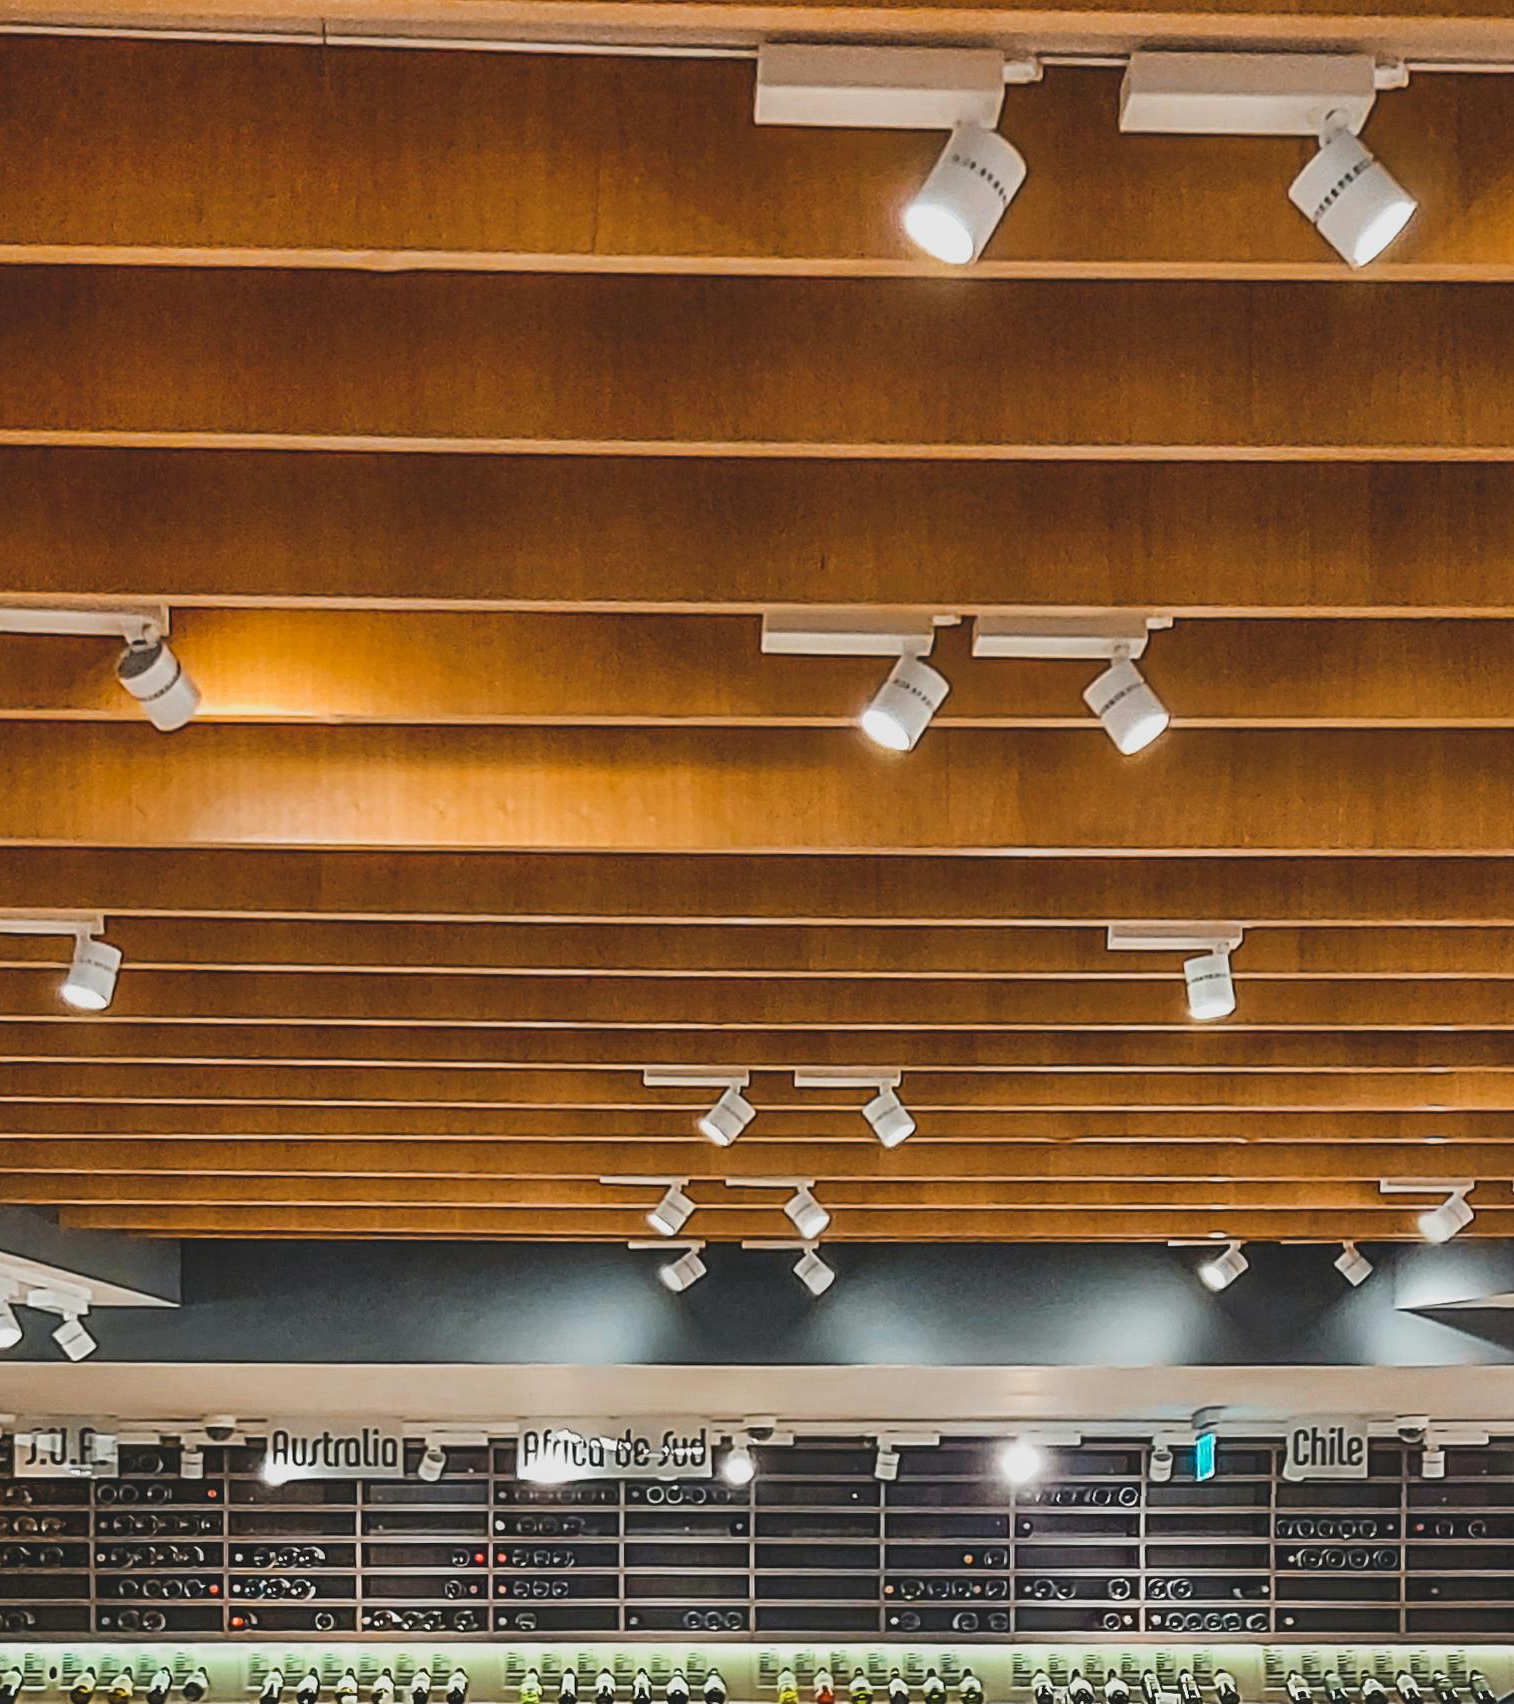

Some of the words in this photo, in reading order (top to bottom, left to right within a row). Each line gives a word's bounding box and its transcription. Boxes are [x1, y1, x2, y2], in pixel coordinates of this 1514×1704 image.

[272, 1428, 398, 1467] Australia
[523, 1429, 605, 1467] Africa
[616, 1428, 650, 1468] de
[657, 1428, 706, 1467] Sud
[1292, 1426, 1364, 1466] Chile
